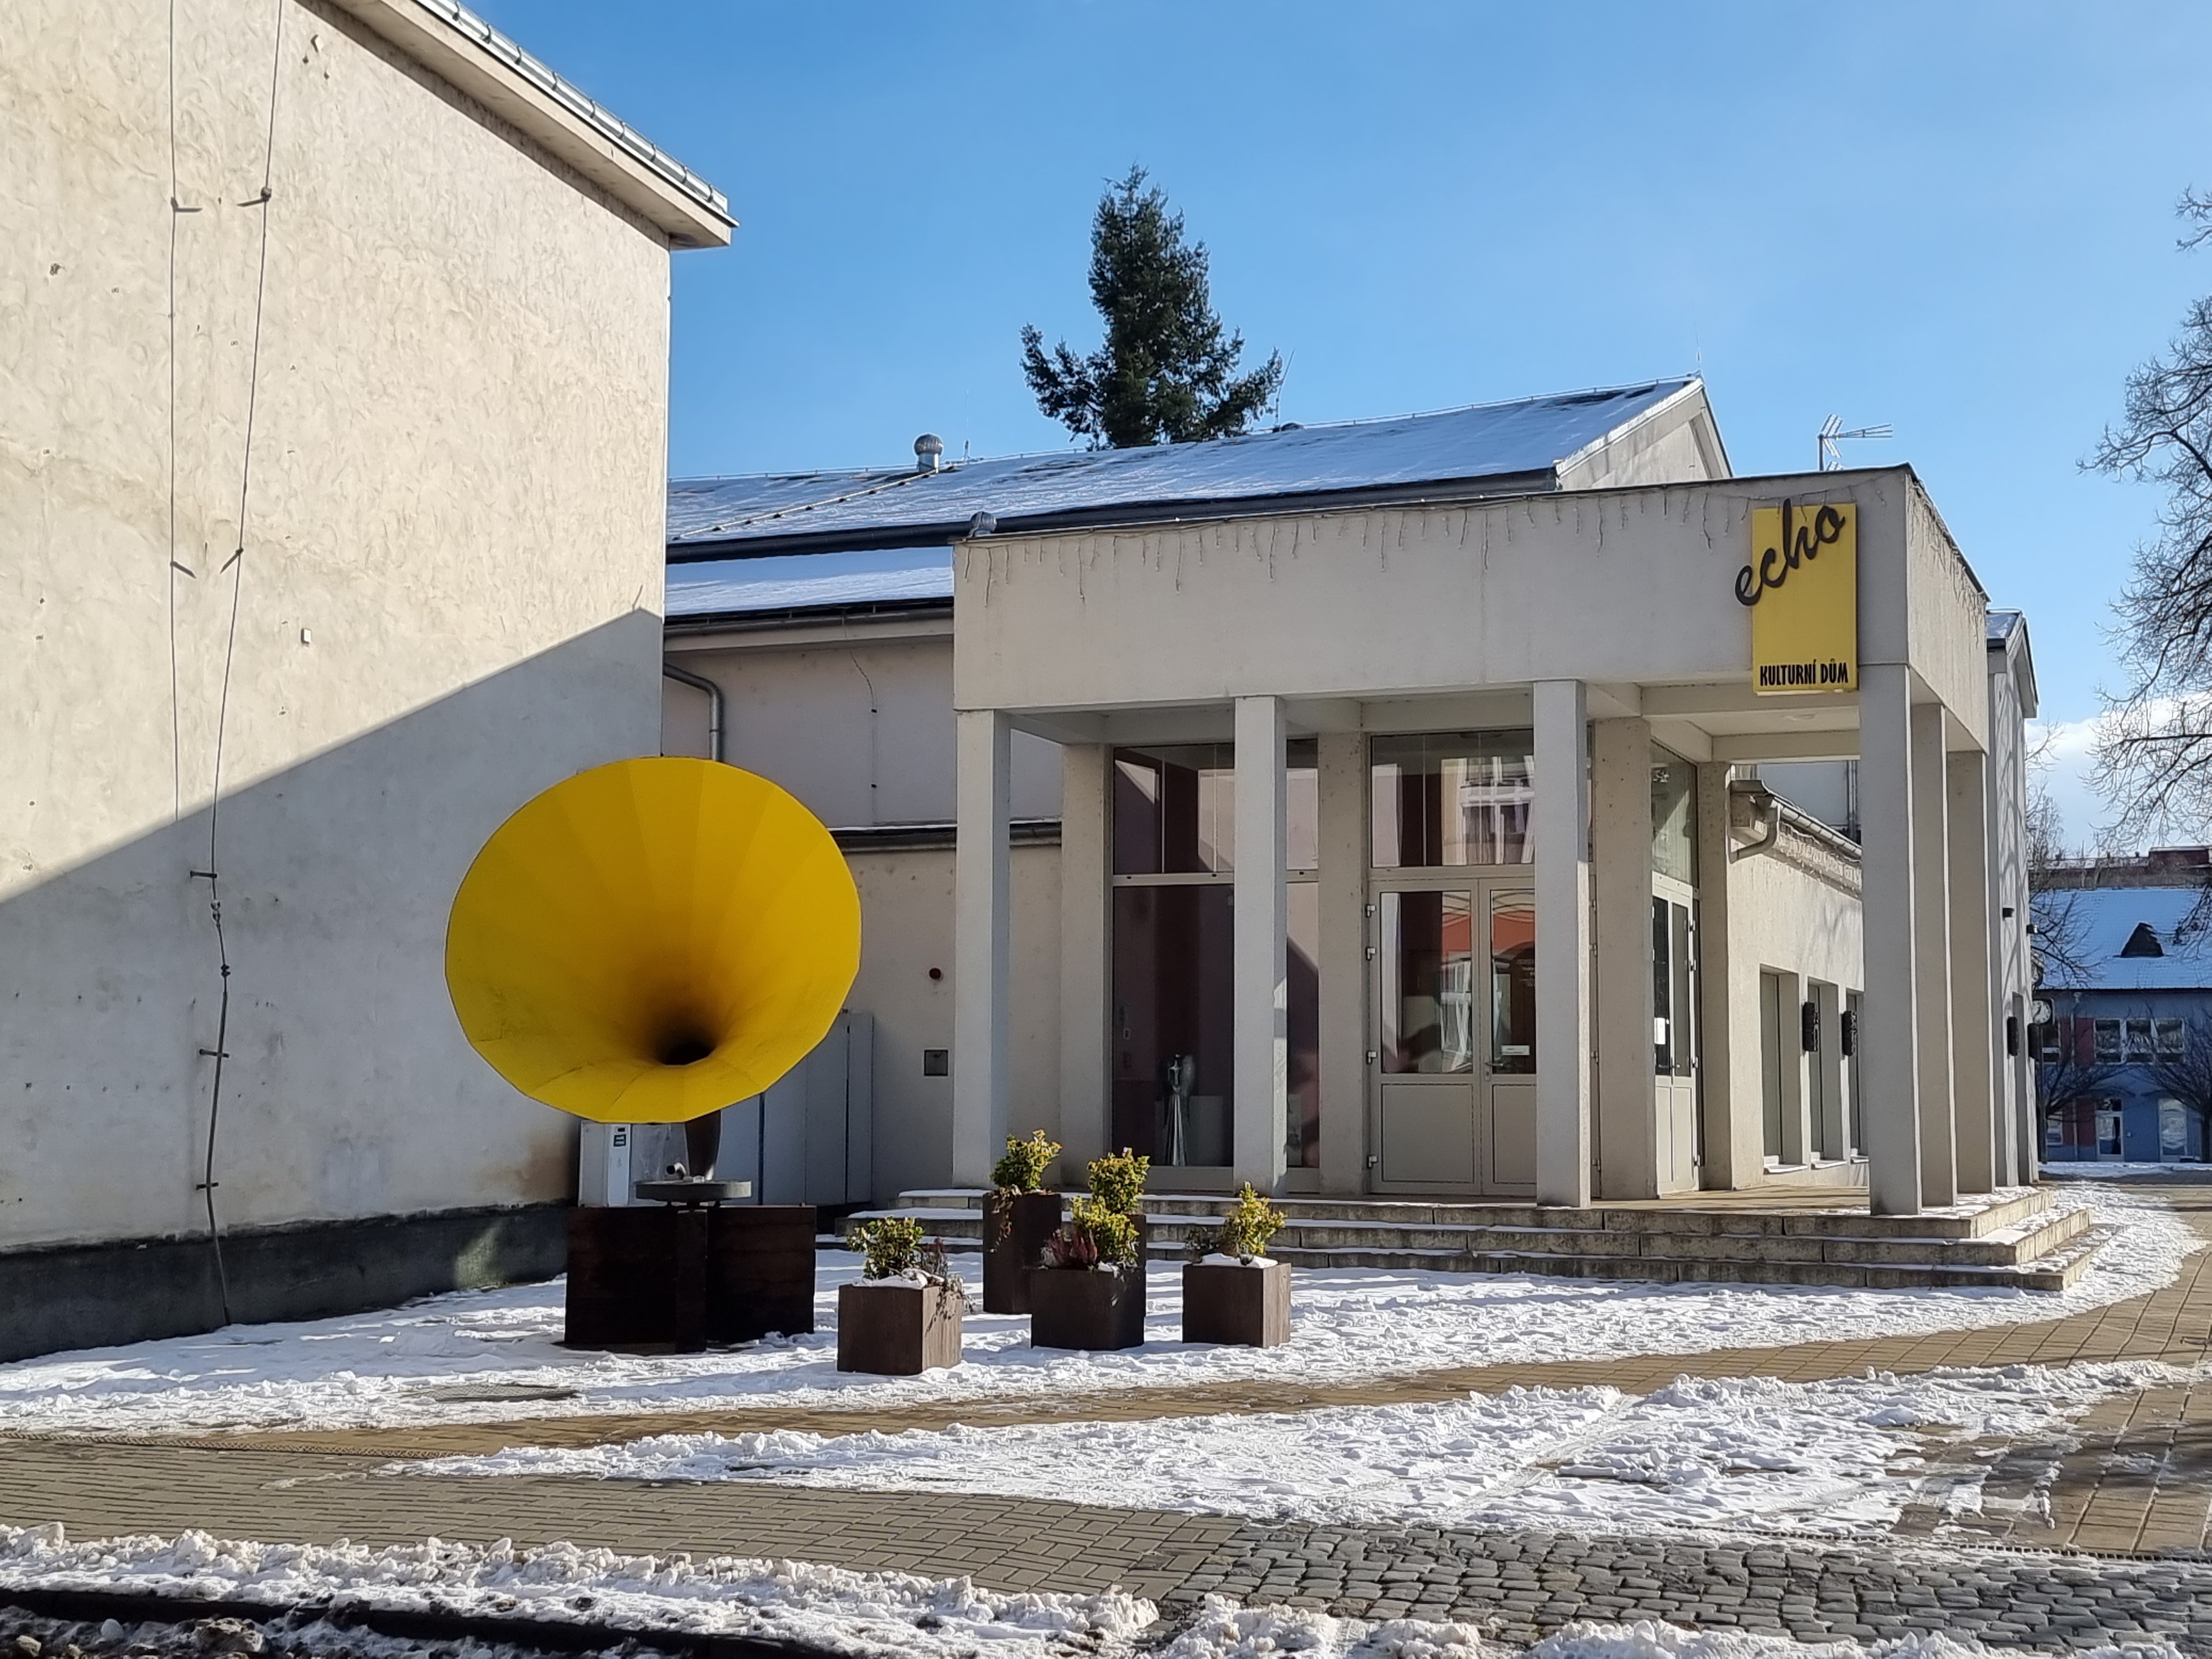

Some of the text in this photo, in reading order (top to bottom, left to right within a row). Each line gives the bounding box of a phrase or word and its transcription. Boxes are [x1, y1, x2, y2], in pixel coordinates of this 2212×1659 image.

[1735, 498, 1845, 606] echo
[1760, 658, 1849, 686] KULTURNÍ DŮM
